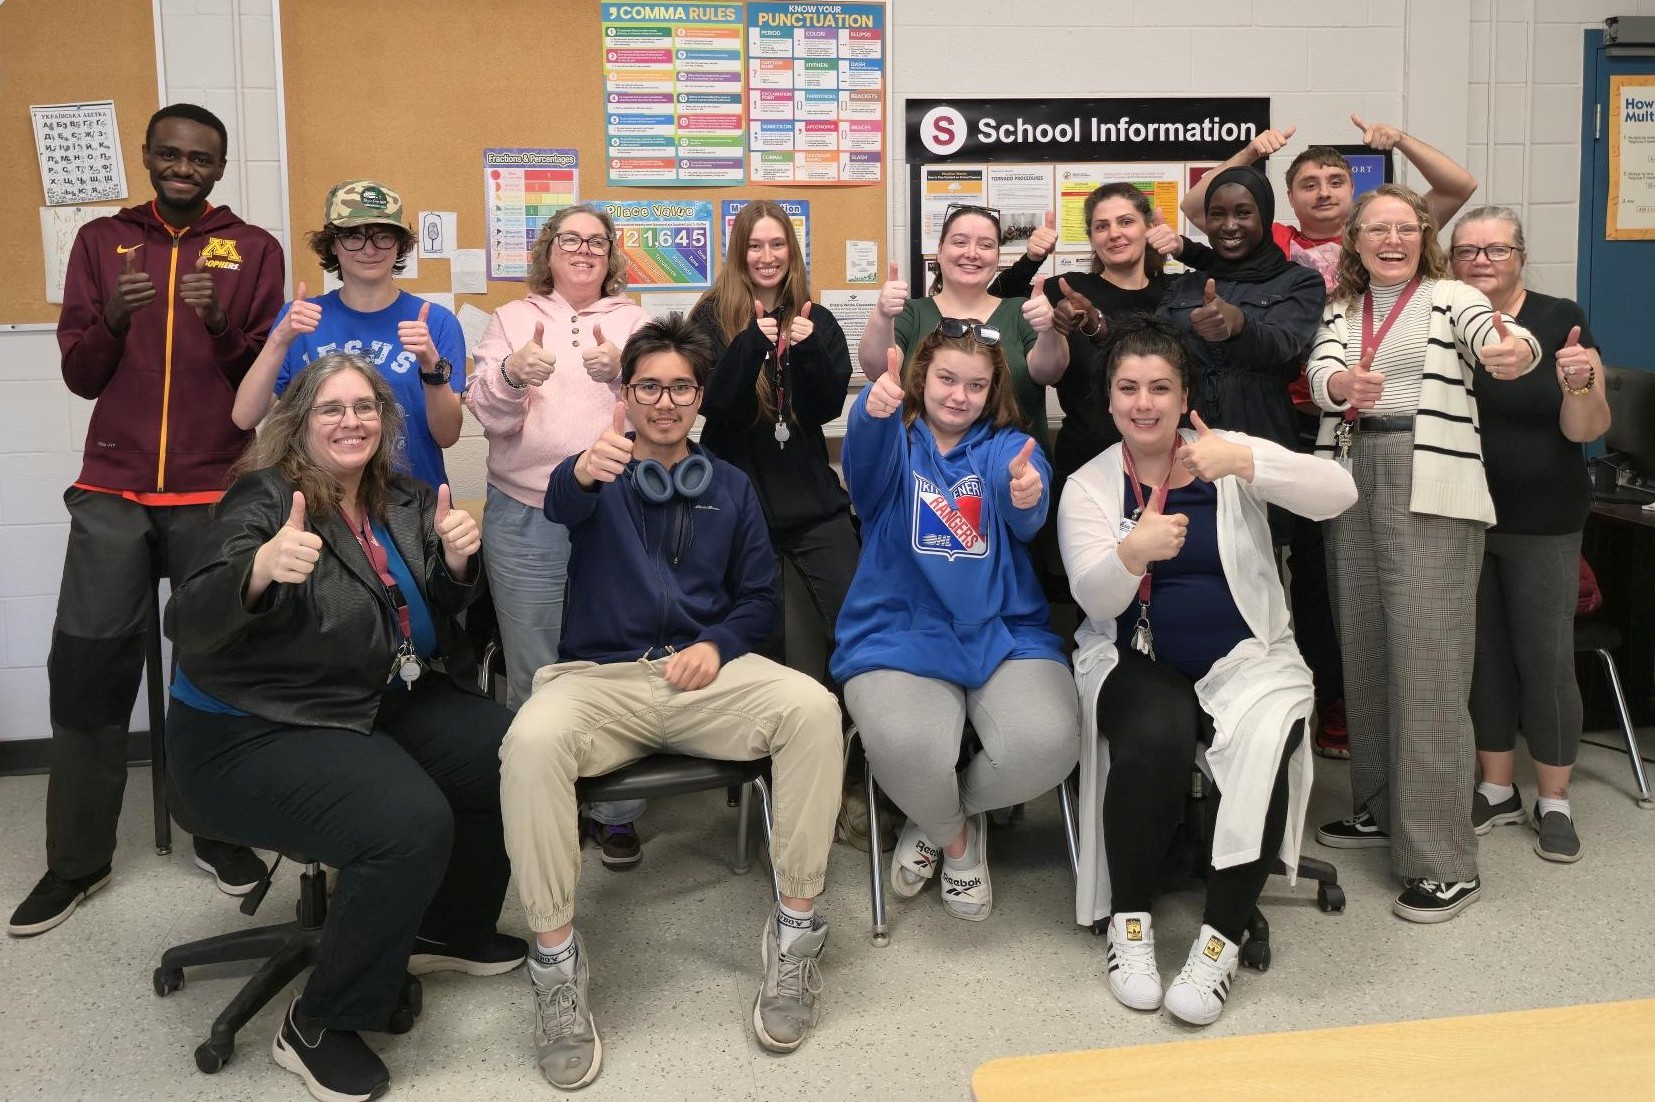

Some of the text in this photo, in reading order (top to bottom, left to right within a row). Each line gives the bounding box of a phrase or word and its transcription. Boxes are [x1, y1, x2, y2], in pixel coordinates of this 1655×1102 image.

[620, 6, 686, 20] COMMA
[689, 7, 735, 20] RULES
[789, 5, 818, 13] KNOW
[758, 12, 874, 28] PUNCTUATION
[1625, 98, 1654, 110] How
[932, 116, 1256, 146] S School Information
[488, 154, 575, 166] Fractions & Percentages
[1351, 165, 1373, 173] ORT
[606, 204, 694, 218] Place Value
[930, 496, 979, 550] RANGERS
[943, 872, 982, 887] Reebok
